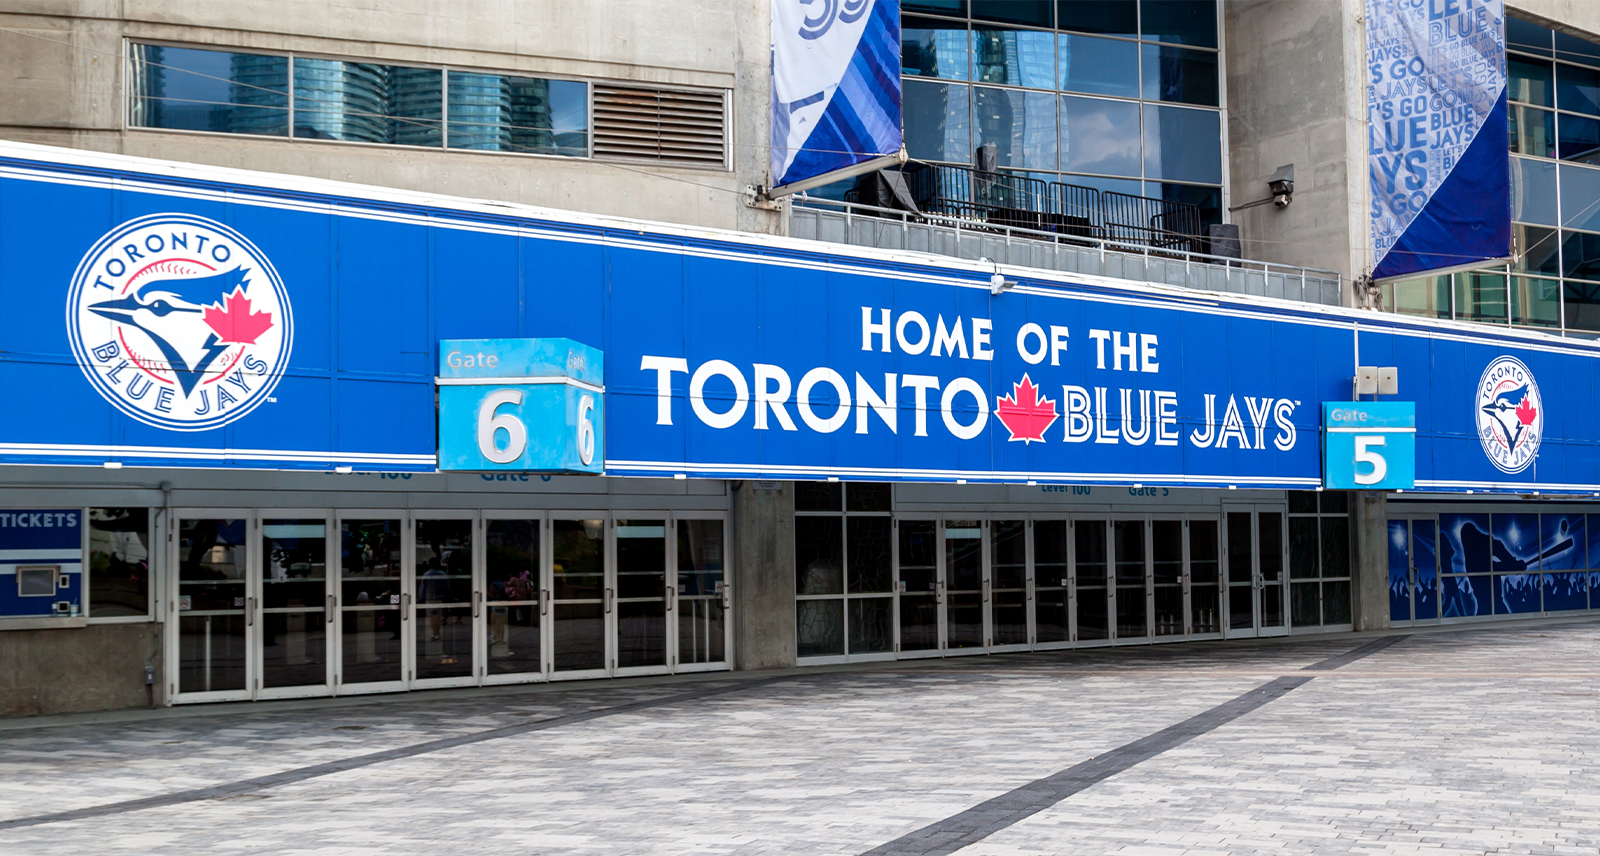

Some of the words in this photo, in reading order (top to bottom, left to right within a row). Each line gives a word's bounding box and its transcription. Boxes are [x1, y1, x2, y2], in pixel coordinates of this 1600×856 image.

[1428, 6, 1488, 47] BLUE
[1368, 45, 1402, 64] JAYS
[1381, 38, 1400, 47] JAYS
[1427, 44, 1447, 56] LET'S
[1450, 41, 1460, 51] GO
[1461, 35, 1478, 48] BLUE
[1480, 28, 1496, 41] JAYS
[1390, 56, 1425, 80] GO
[1450, 60, 1460, 69] GO
[1461, 53, 1478, 66] BLUE
[1480, 47, 1496, 61] JAYS
[1380, 75, 1428, 101] JAYS
[1428, 66, 1473, 94] LET'S
[1399, 95, 1427, 117] GO
[1430, 90, 1457, 112] GO
[1430, 104, 1473, 131] BLUE
[1430, 122, 1474, 150] JAYS
[1390, 190, 1427, 215] GO
[93, 232, 231, 291] TORONTO
[861, 306, 994, 361] HOME
[1016, 322, 1069, 366] OF
[1089, 328, 1159, 373] THE
[447, 351, 499, 369] Gate
[568, 351, 586, 372] Gate
[91, 340, 175, 414] BLUE
[194, 353, 268, 416] JAYS
[1483, 366, 1524, 400] TORONTO
[640, 355, 989, 440] TORONTO
[1062, 385, 1179, 446] BLUE
[1189, 393, 1296, 451] JAYS
[1331, 408, 1368, 421] Gate
[477, 389, 527, 465] 6
[577, 394, 595, 466] 6
[1483, 425, 1509, 464] BLUE
[1513, 430, 1537, 465] JAYS
[1354, 435, 1387, 485] 5
[1128, 487, 1157, 497] Gate
[0, 513, 77, 528] TICKETS
